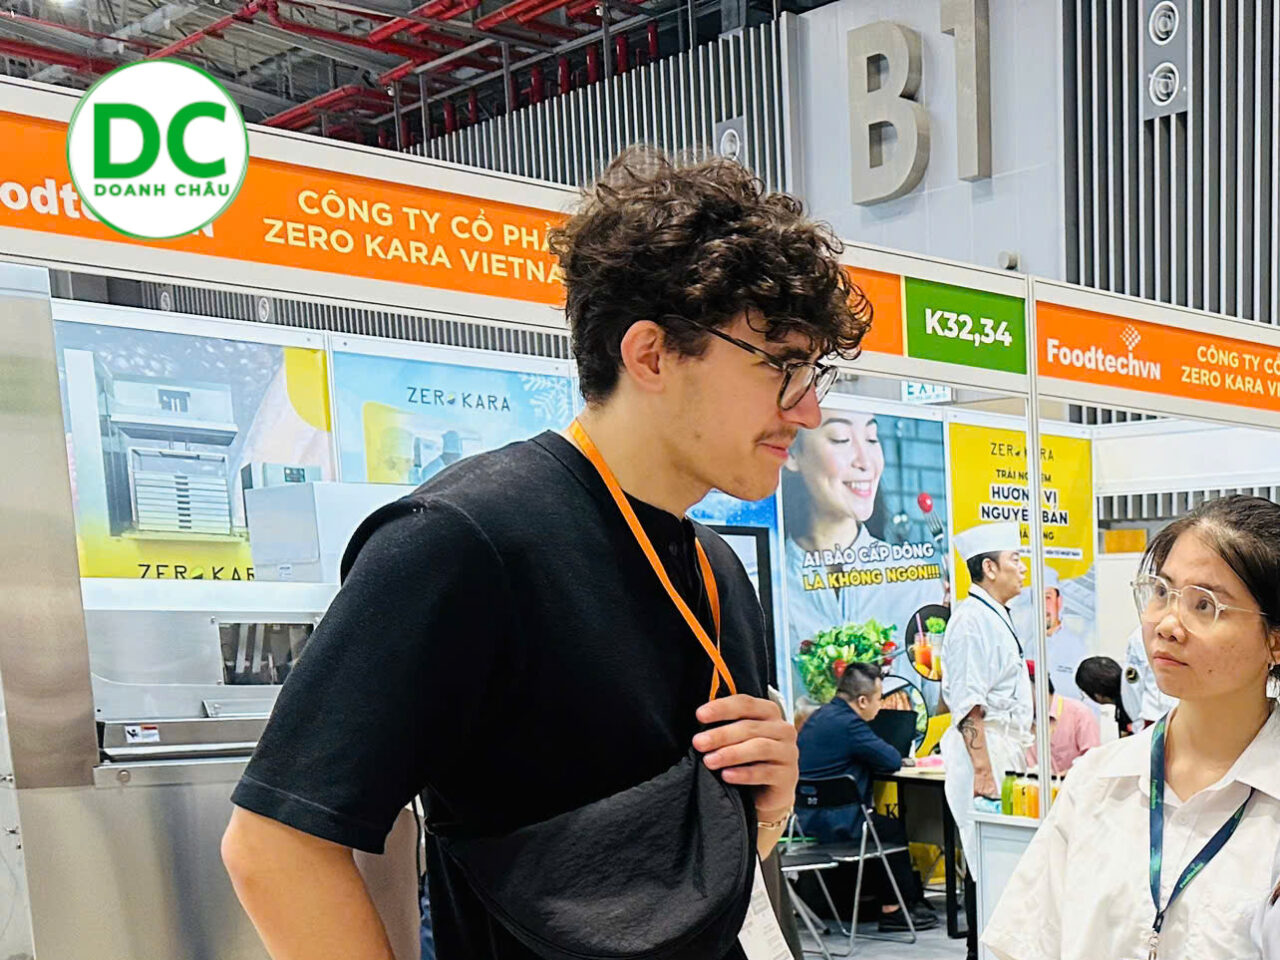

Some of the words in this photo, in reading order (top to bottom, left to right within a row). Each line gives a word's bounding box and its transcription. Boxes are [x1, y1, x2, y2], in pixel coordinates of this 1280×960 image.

[298, 189, 393, 226] CÔNG
[402, 207, 440, 234] TY
[451, 208, 493, 243] CỔ
[263, 218, 354, 254] ZERO
[365, 233, 451, 269] KARA
[460, 249, 564, 284] VIETNA
[925, 308, 1013, 347] K32,34
[1197, 344, 1239, 368] CÔNG
[1242, 354, 1260, 371] TY
[1181, 366, 1221, 387] ZERO
[1225, 374, 1264, 395] KARA
[462, 391, 512, 413] KARA
[992, 486, 1030, 501] HƯƠN
[981, 505, 1029, 521] NGUYÊ
[803, 551, 820, 569] AI
[858, 541, 890, 563] CẤP
[828, 568, 882, 589] KHÔNG
[886, 564, 941, 583] NGON!!!
